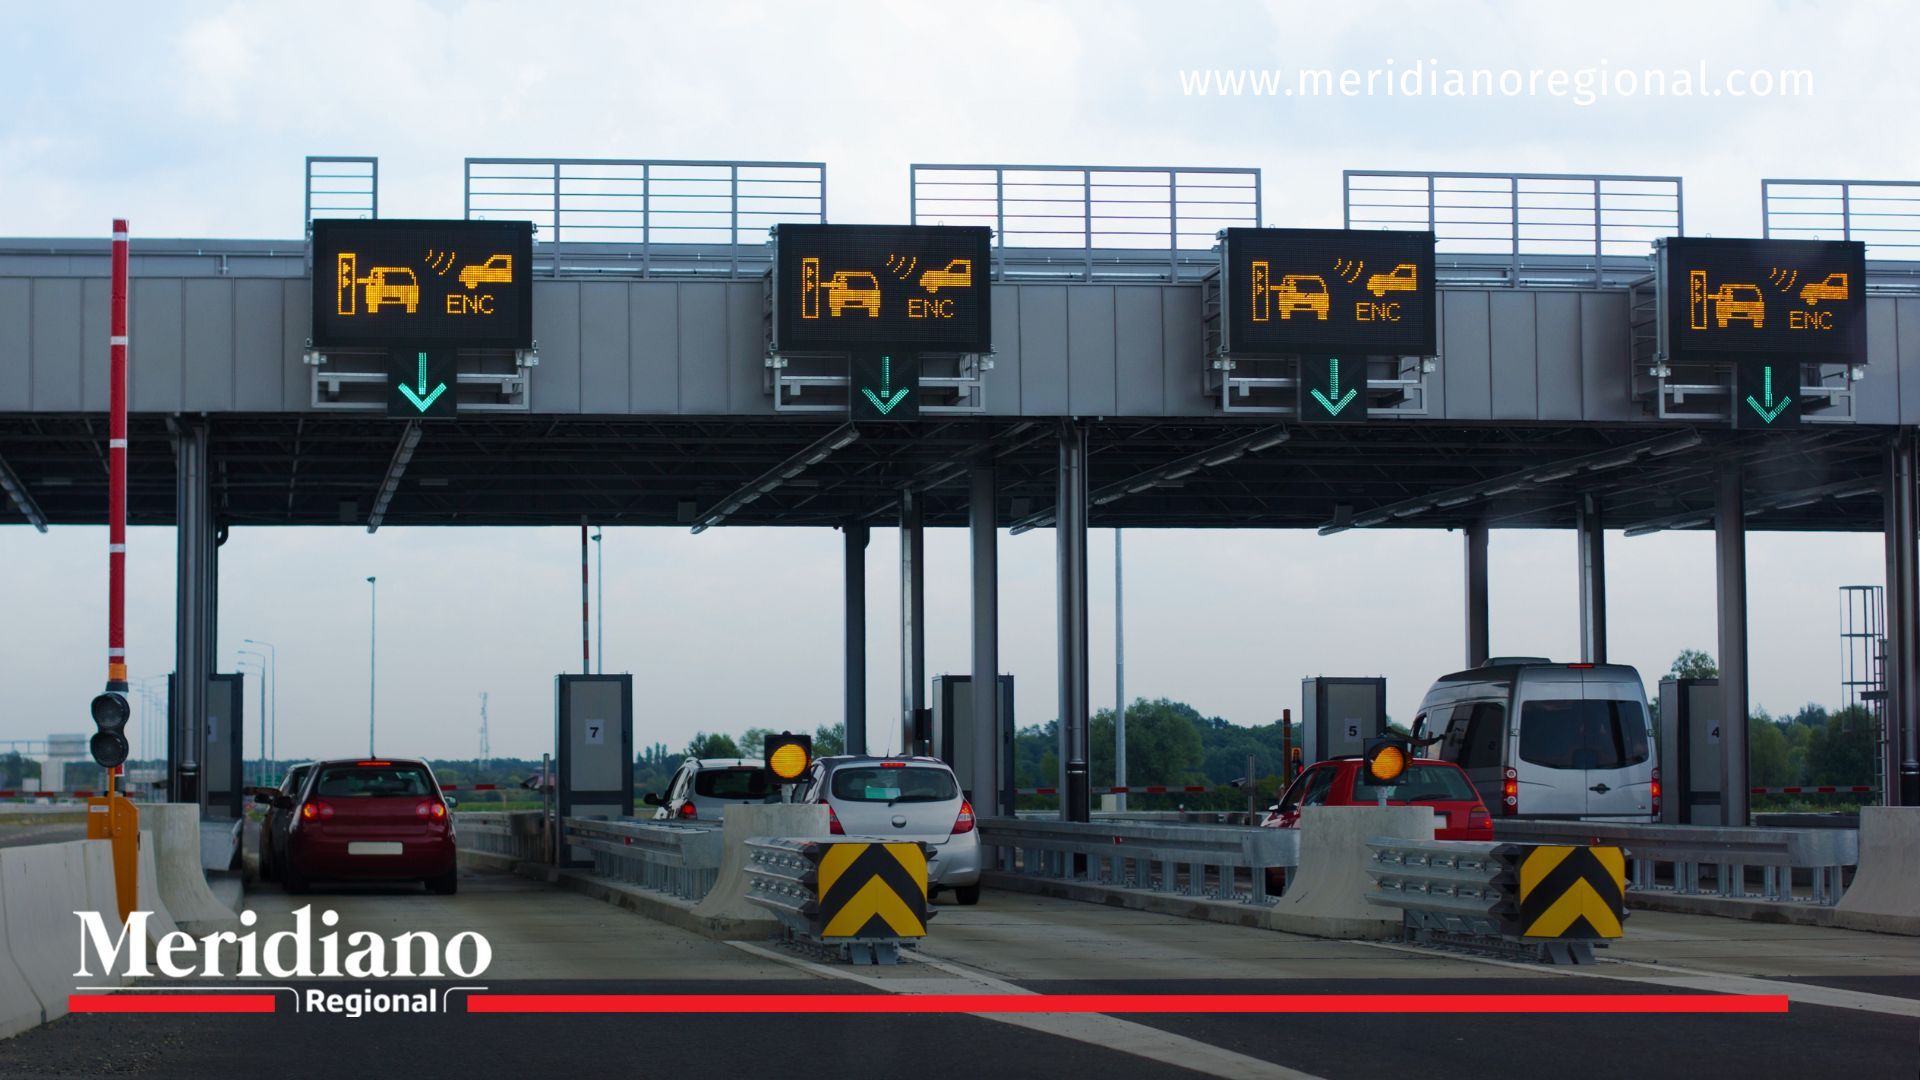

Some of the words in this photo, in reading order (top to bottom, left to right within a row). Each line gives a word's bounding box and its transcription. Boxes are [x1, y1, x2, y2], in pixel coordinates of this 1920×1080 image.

[446, 294, 494, 315] ENC
[908, 298, 954, 318] ENC
[1355, 302, 1401, 321] ENC
[1789, 310, 1833, 330] ENC
[589, 726, 599, 738] 7
[1348, 725, 1358, 737] 5
[1711, 726, 1720, 739] 4
